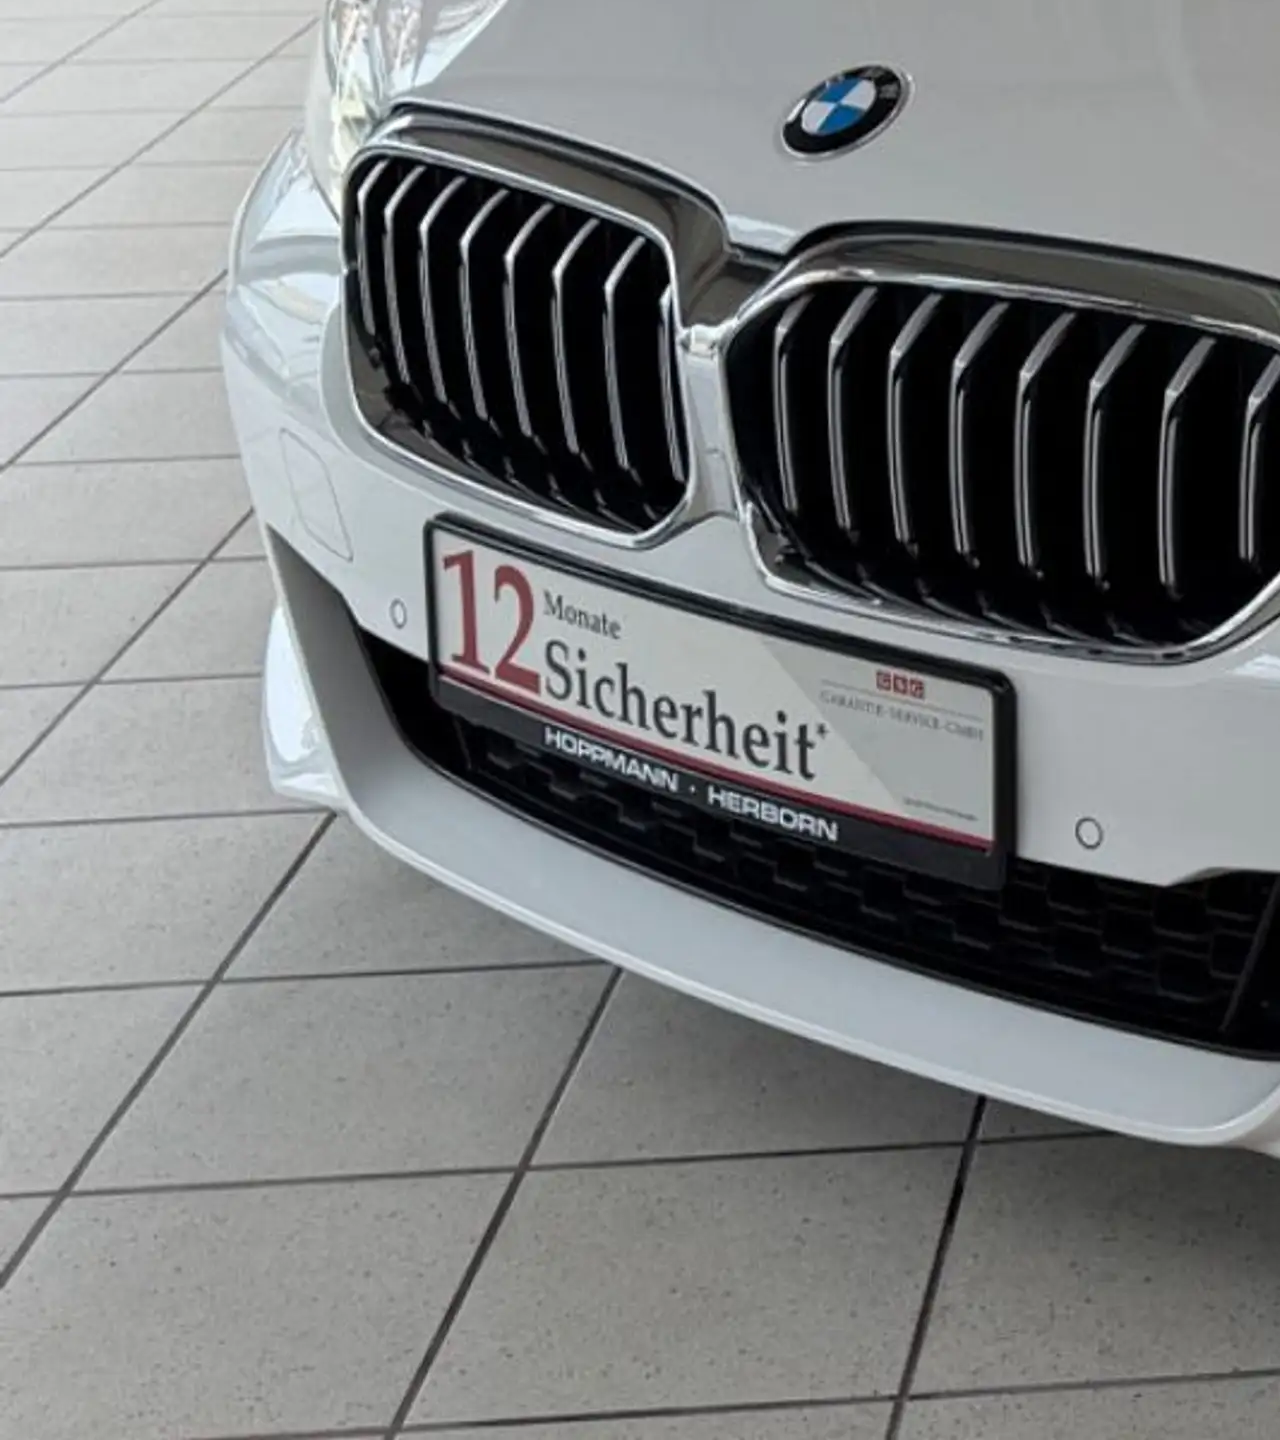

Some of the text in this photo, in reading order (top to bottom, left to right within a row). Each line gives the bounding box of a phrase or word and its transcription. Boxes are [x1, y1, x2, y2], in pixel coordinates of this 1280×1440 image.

[443, 550, 541, 696] 12
[543, 589, 621, 639] Monate
[545, 727, 679, 793] HOPPMANN
[707, 785, 838, 842] HERBORN
